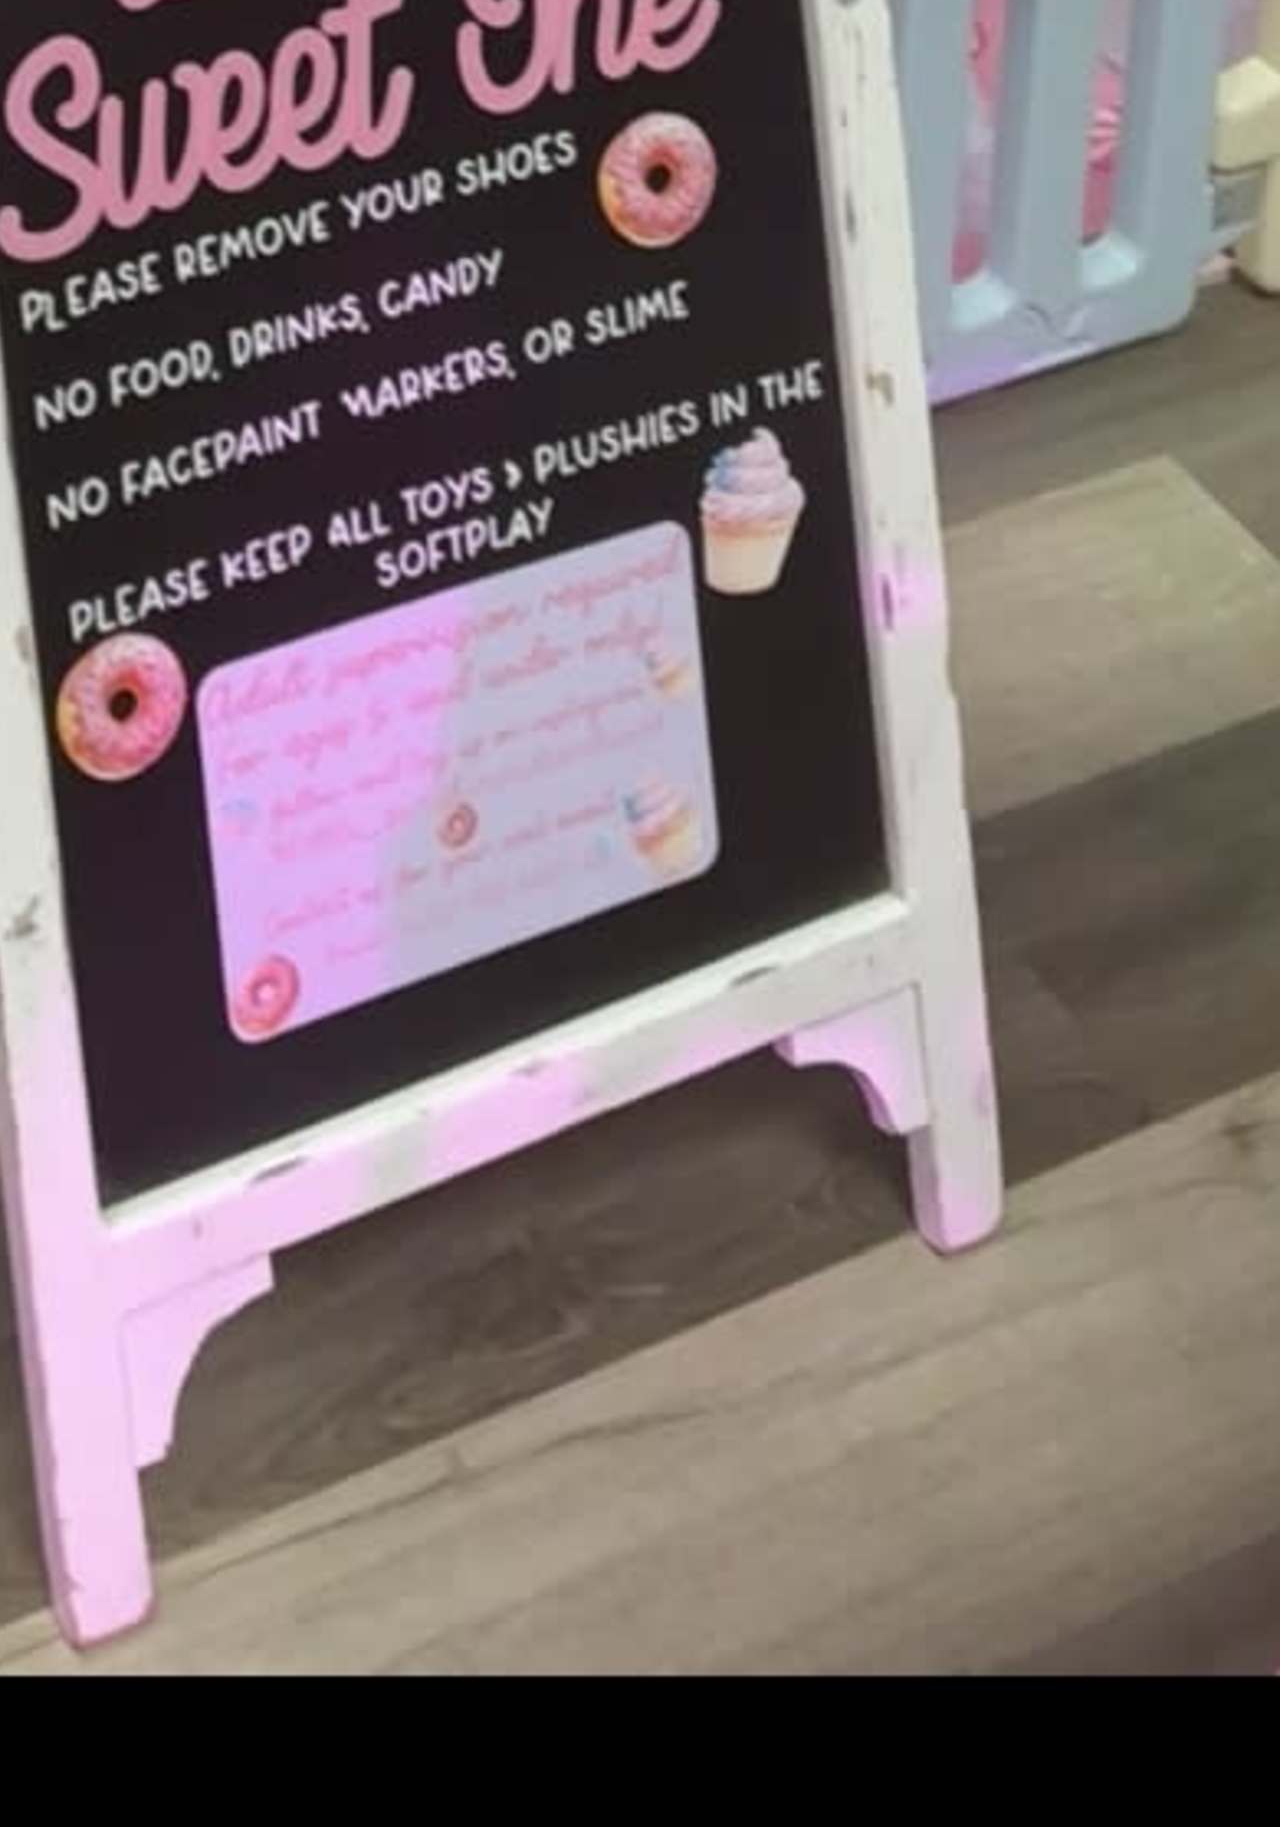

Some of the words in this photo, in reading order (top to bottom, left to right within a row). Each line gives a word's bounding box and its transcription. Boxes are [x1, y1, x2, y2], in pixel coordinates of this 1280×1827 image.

[20, 251, 162, 332] PLEASE
[174, 200, 331, 282] REMOVE
[339, 168, 444, 230] YOUR
[455, 130, 578, 195] SHOES
[34, 378, 98, 432] NO
[109, 339, 222, 406] FOOD,
[227, 293, 370, 369] DRINKS,
[377, 248, 504, 319] CANDY
[46, 475, 109, 531] NO
[120, 400, 322, 504] FACEPAINT
[523, 318, 574, 364] OR
[584, 280, 691, 345] SLIME
[69, 558, 211, 642] PLEASE
[219, 524, 312, 588] KEEP
[326, 499, 392, 547] ALL
[399, 465, 495, 525] TOYS
[532, 399, 701, 484] PLUSHIES
[709, 382, 748, 427] IN
[757, 360, 825, 411] THE
[374, 495, 555, 588] SOFTPLAY
